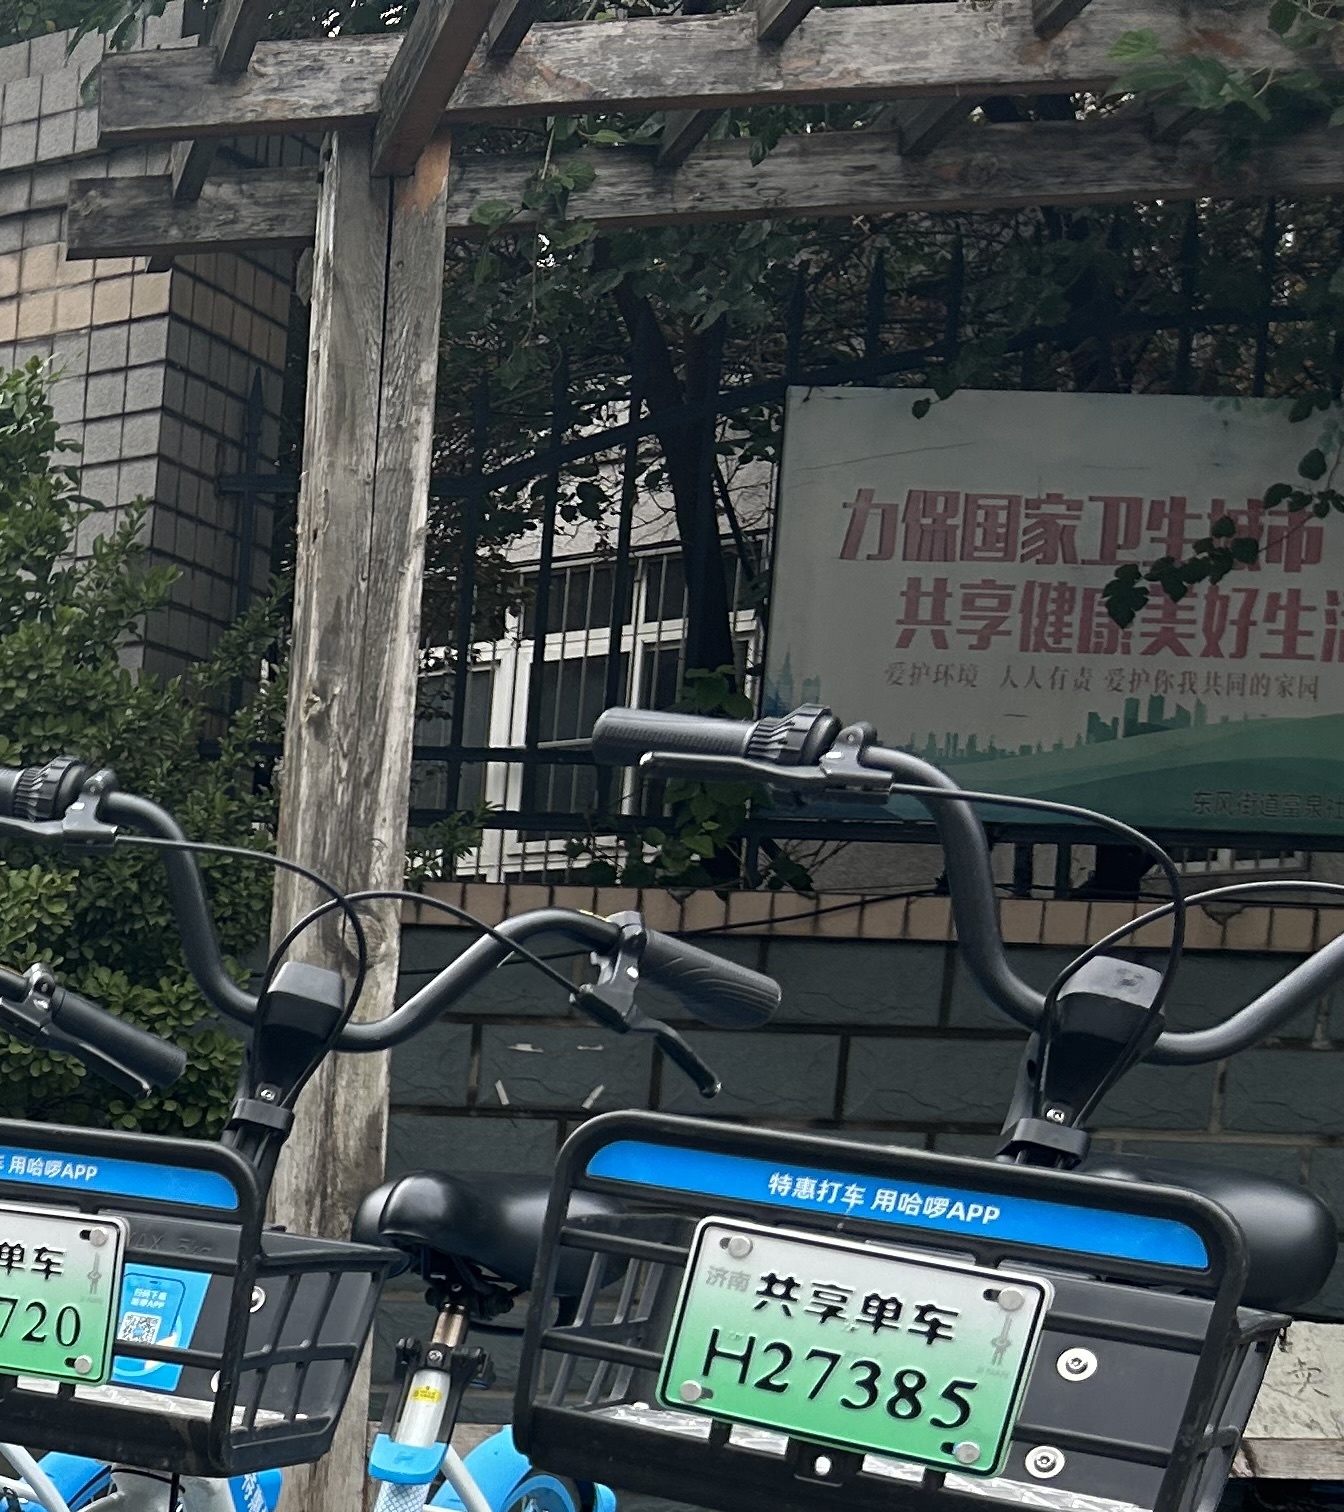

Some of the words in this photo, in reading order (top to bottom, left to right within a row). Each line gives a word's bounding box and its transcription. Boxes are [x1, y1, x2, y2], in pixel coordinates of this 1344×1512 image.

[884, 662, 979, 689] 爱护环境
[1000, 666, 1092, 694] 人人有责
[1105, 668, 1319, 702] 爱护你我共同的家园
[8, 1155, 97, 1183] 用哈啰APP
[768, 1172, 865, 1211] 特惠打车
[871, 1187, 1001, 1226] 用哈啰APP
[706, 1265, 749, 1294] 济南
[752, 1270, 961, 1345] 共享单车
[702, 1327, 979, 1430] H27385
